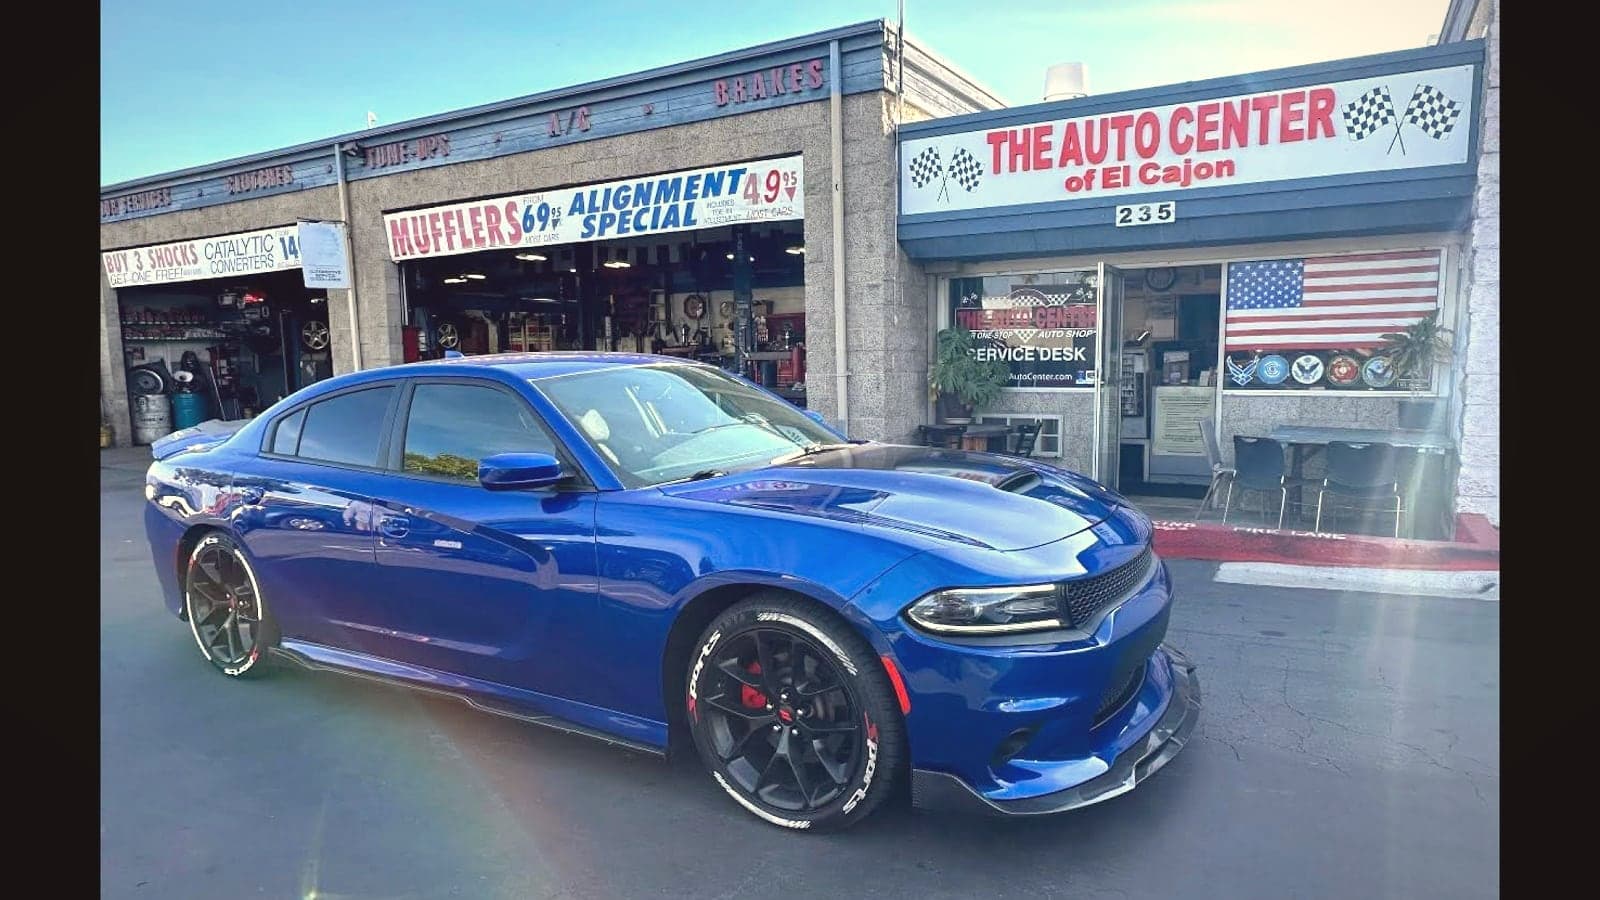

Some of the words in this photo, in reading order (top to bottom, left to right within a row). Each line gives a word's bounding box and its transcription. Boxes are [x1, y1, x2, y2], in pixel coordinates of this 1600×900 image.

[714, 60, 824, 107] BRAKES
[548, 106, 592, 137] A/C
[986, 124, 1053, 175] THE
[1059, 105, 1162, 168] AUTO
[1168, 88, 1336, 155] CENTER
[365, 134, 450, 169] TUNE-UPS
[224, 165, 294, 193] CLUTCHES
[742, 169, 782, 205] 49
[784, 171, 798, 186] 95
[1064, 167, 1096, 193] of
[1101, 164, 1131, 189] El
[1138, 157, 1236, 188] Cajon
[120, 186, 172, 212] SERVICES
[568, 168, 748, 216] ALIGNMENT
[522, 202, 550, 234] 69
[551, 206, 562, 218] 95
[580, 201, 698, 239] SPECIAL
[771, 206, 793, 217] CARS
[1118, 203, 1173, 228] 235
[389, 200, 523, 258] MUFFLERS
[105, 252, 129, 274] BUY
[134, 250, 144, 272] 3
[147, 243, 199, 270] SHOCKS
[204, 233, 274, 260] CATALYTIC
[280, 235, 301, 260] 14
[110, 272, 128, 286] GET
[131, 270, 152, 284] ONE
[210, 252, 274, 275] CONVERTERS
[1037, 330, 1065, 339] AUTO
[1040, 346, 1088, 362] DESK
[1233, 525, 1282, 535] FIRE
[1291, 529, 1347, 540] LANE
